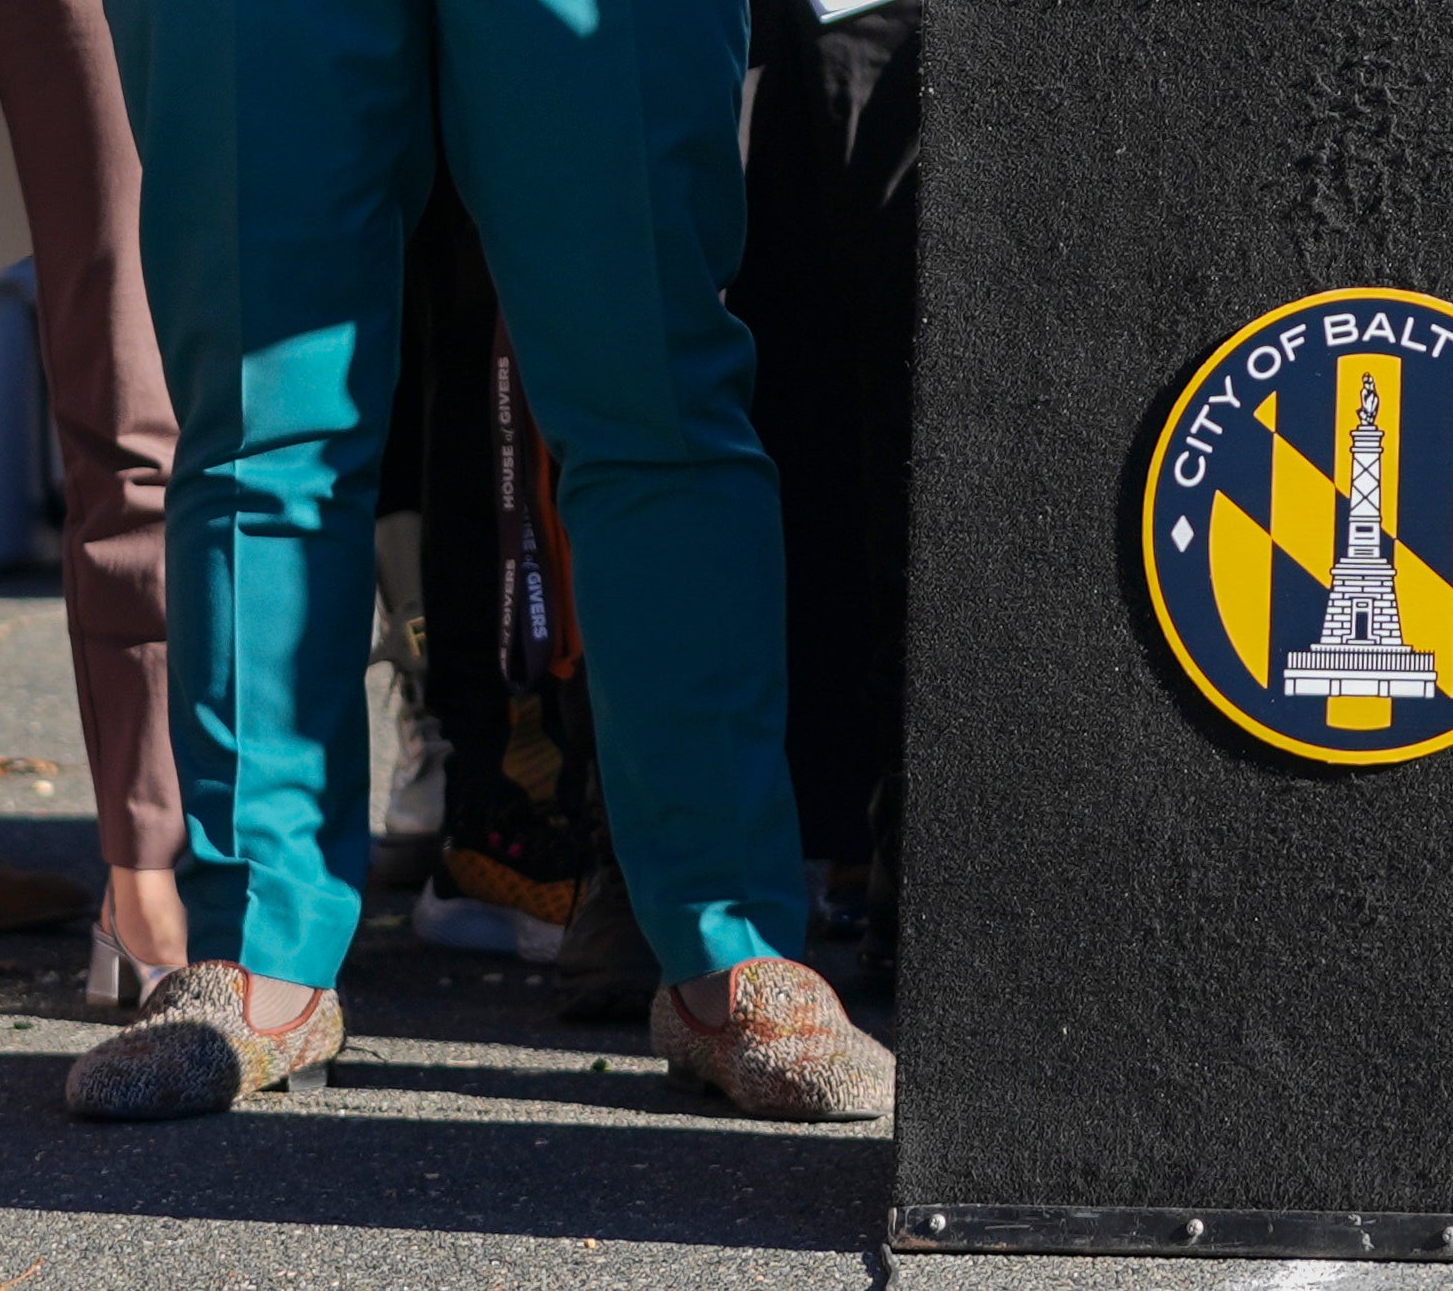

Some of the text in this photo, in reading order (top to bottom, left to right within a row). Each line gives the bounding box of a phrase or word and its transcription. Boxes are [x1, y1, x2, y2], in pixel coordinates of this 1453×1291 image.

[497, 356, 512, 425] GIVERS
[1174, 375, 1241, 488] CITY
[1247, 324, 1307, 380] OF
[501, 445, 515, 510] HOUSE
[527, 570, 549, 640] GIVERS
